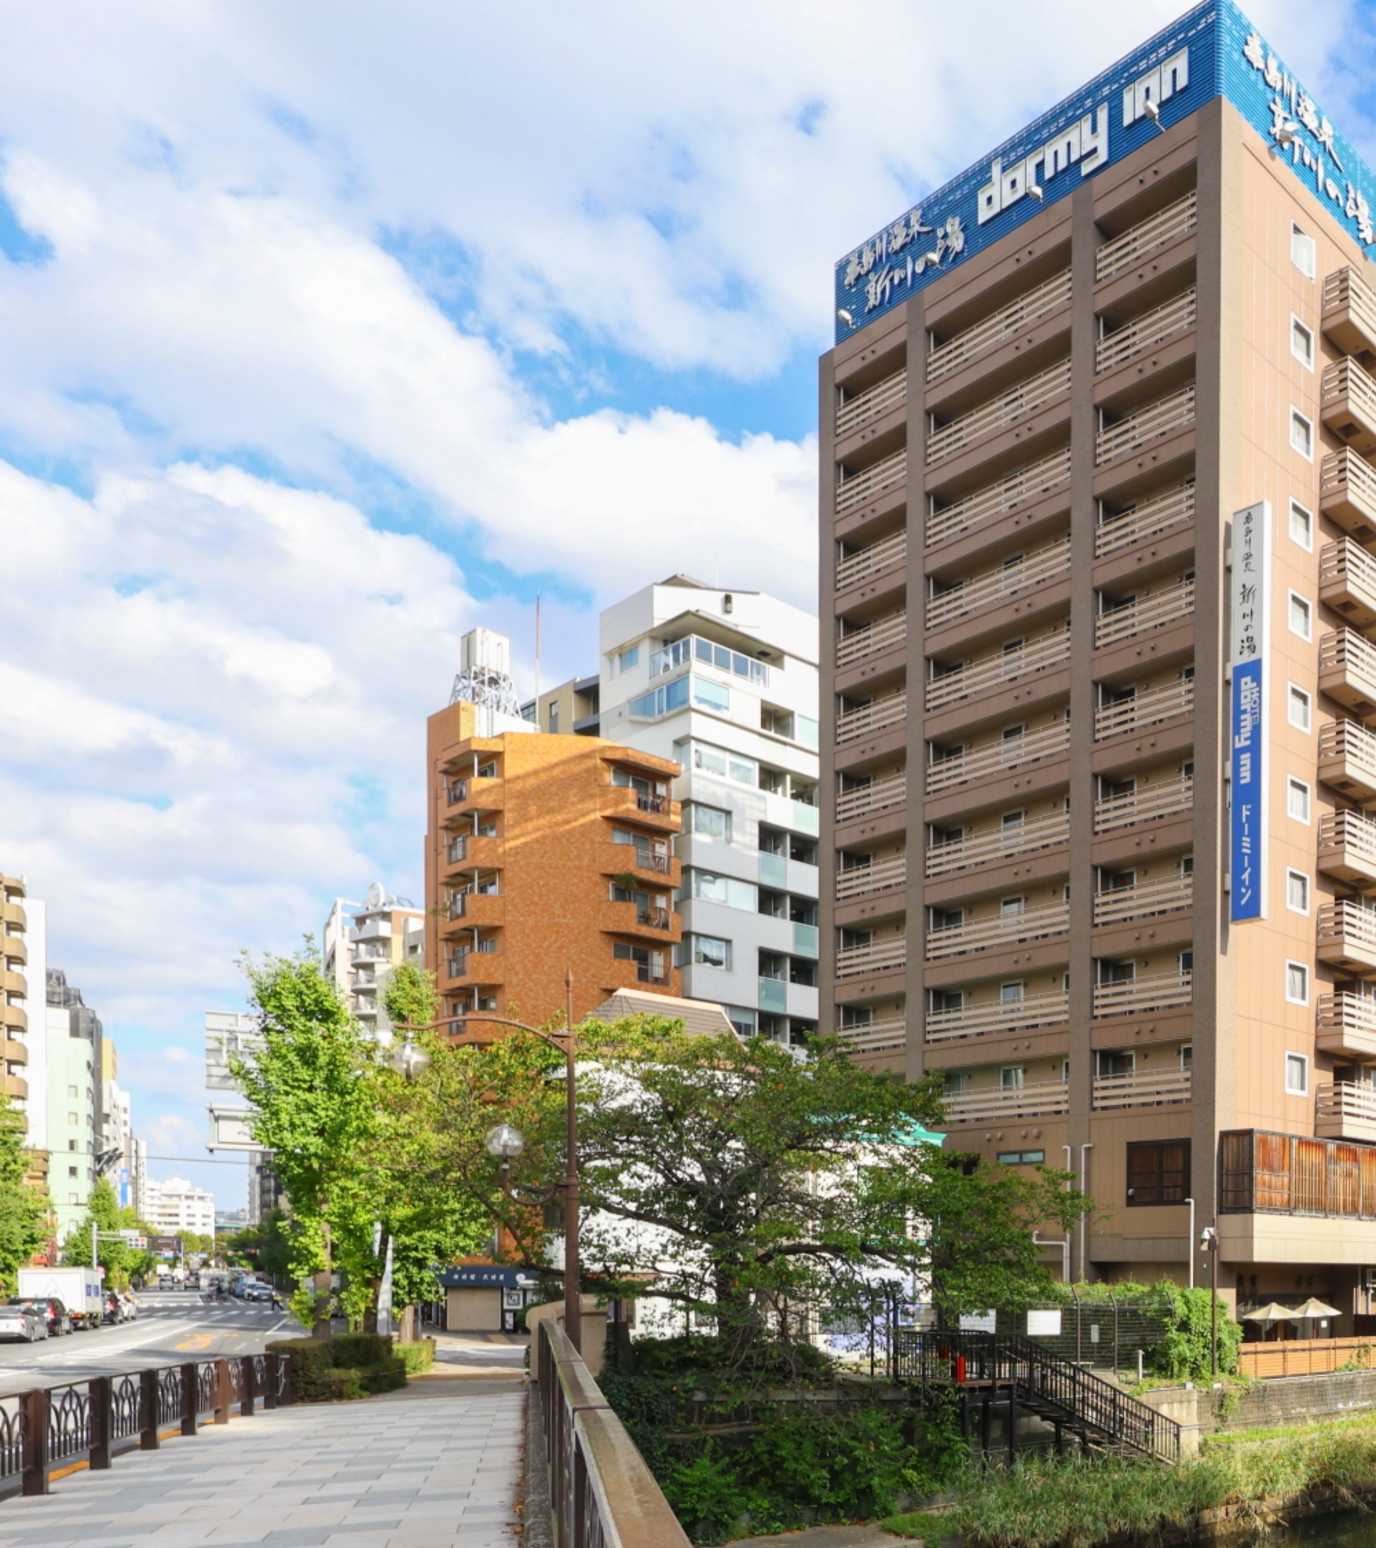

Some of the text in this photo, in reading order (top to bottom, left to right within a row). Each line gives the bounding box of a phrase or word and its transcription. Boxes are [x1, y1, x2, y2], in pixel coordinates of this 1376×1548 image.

[978, 46, 1189, 227] dormy inn
[1239, 583, 1257, 658] 新川の湯
[1235, 675, 1257, 785] dormy inn
[1240, 804, 1252, 906] ドーミーイン
